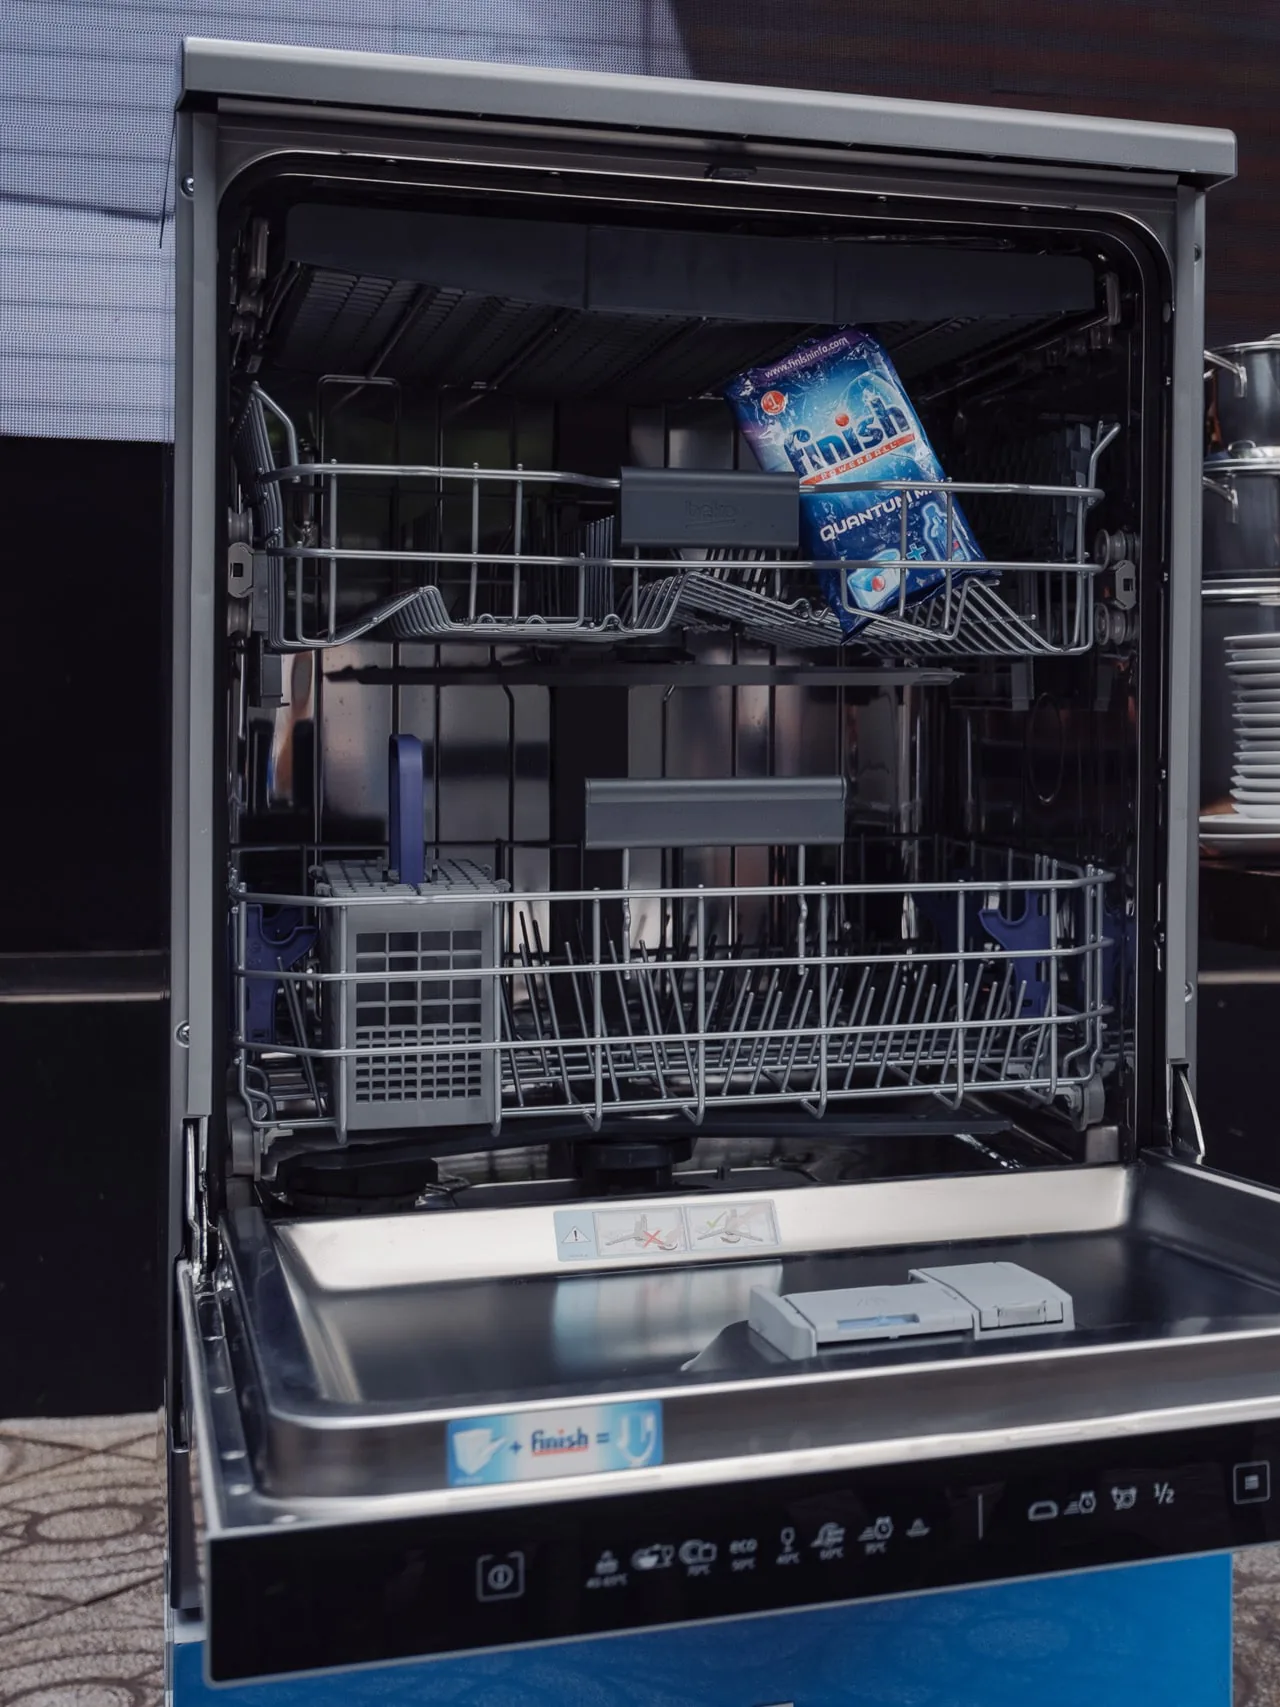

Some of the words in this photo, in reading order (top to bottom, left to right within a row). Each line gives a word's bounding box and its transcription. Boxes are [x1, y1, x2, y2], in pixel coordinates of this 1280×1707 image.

[785, 396, 912, 479] finish
[820, 440, 899, 481] POWERBALL
[531, 1427, 588, 1453] finish
[729, 1537, 758, 1555] eco
